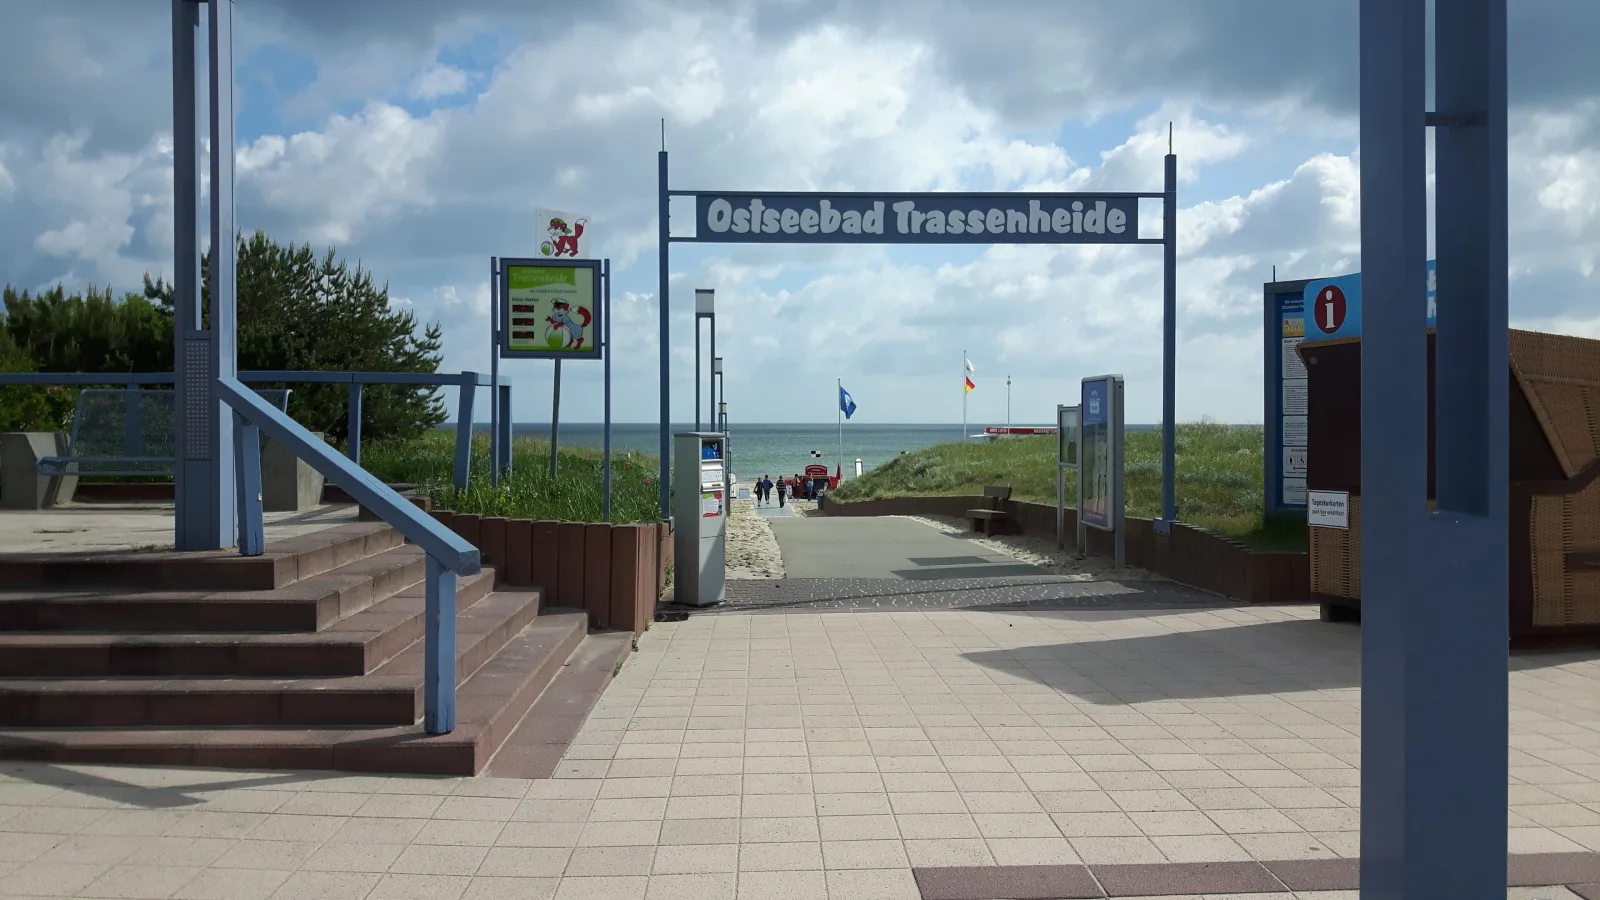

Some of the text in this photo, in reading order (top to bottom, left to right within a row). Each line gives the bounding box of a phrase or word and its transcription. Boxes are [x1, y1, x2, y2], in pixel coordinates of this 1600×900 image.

[707, 199, 1128, 235] Ostseebad Trassenheide
[1324, 290, 1336, 329] i
[1311, 498, 1344, 508] Tageskurkarten
